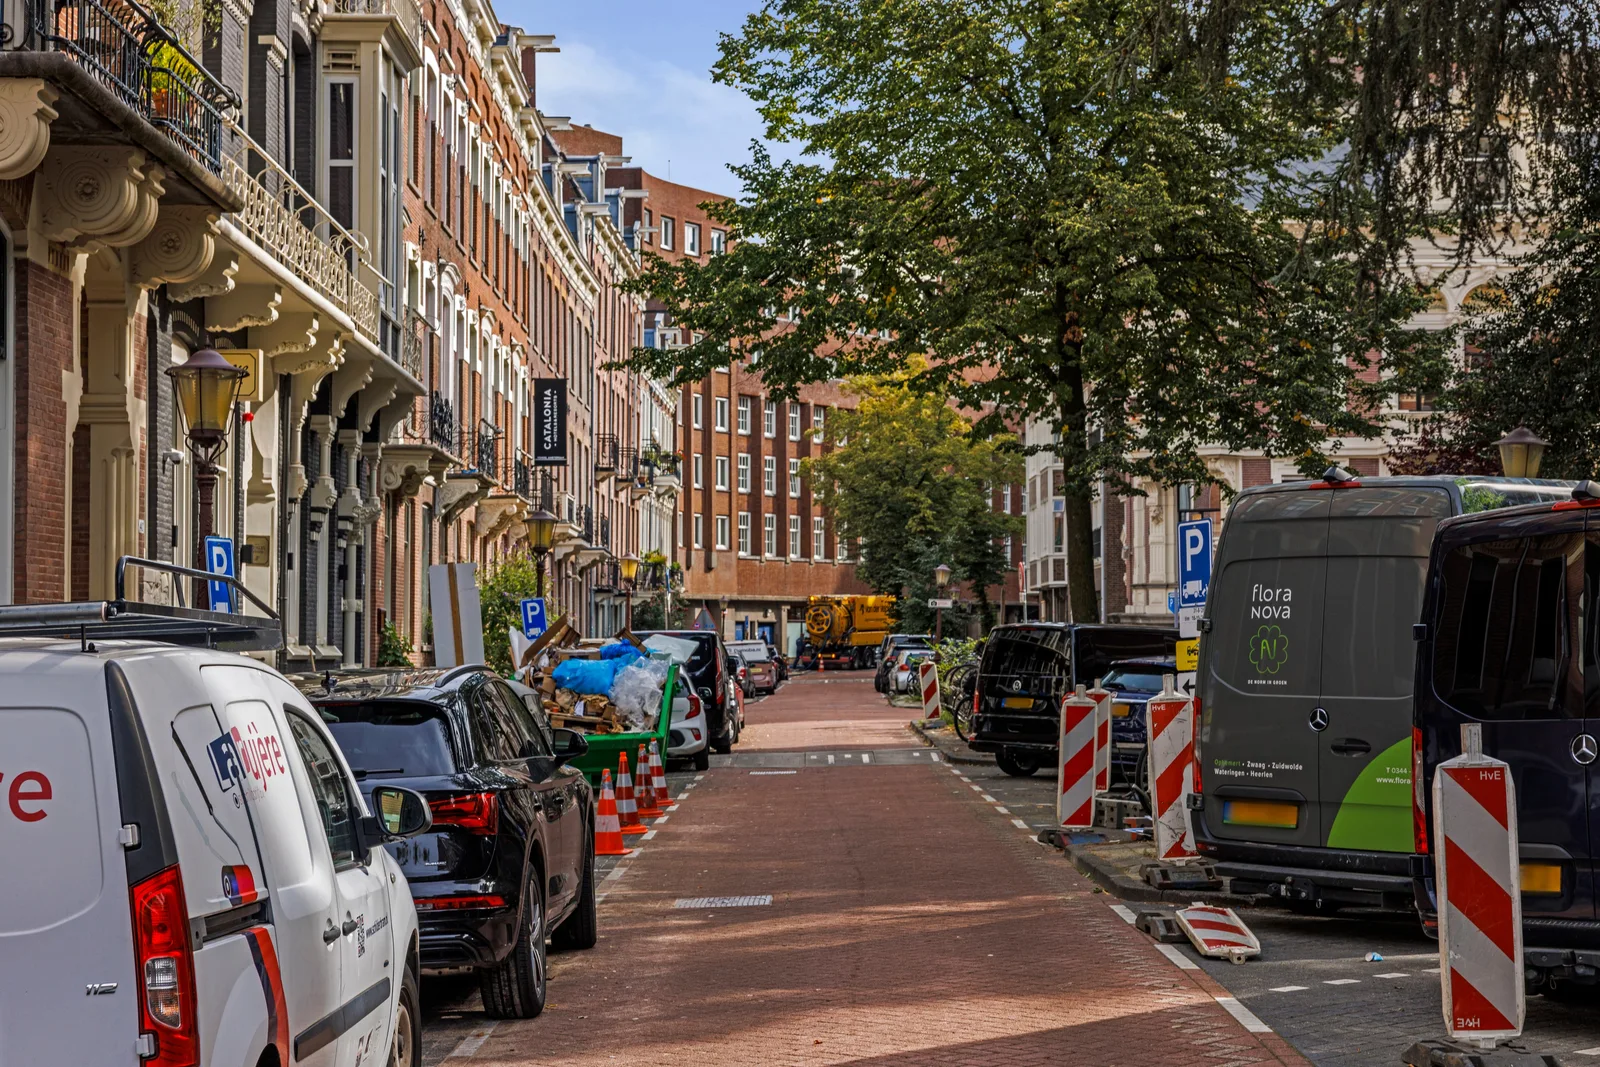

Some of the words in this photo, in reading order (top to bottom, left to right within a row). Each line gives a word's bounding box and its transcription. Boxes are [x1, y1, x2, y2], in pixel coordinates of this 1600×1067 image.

[543, 388, 552, 450] CATALONIA
[1185, 529, 1204, 571] P
[212, 546, 227, 591] P
[1252, 584, 1292, 602] flora
[526, 602, 540, 623] P
[1214, 768, 1245, 777] Wateringen
[1250, 770, 1273, 778] Heerlen
[1246, 761, 1266, 770] Zwaag
[1271, 762, 1303, 771] Zuidwolde
[1479, 770, 1501, 780] HvE
[0, 770, 53, 823] e
[85, 982, 118, 996] 112
